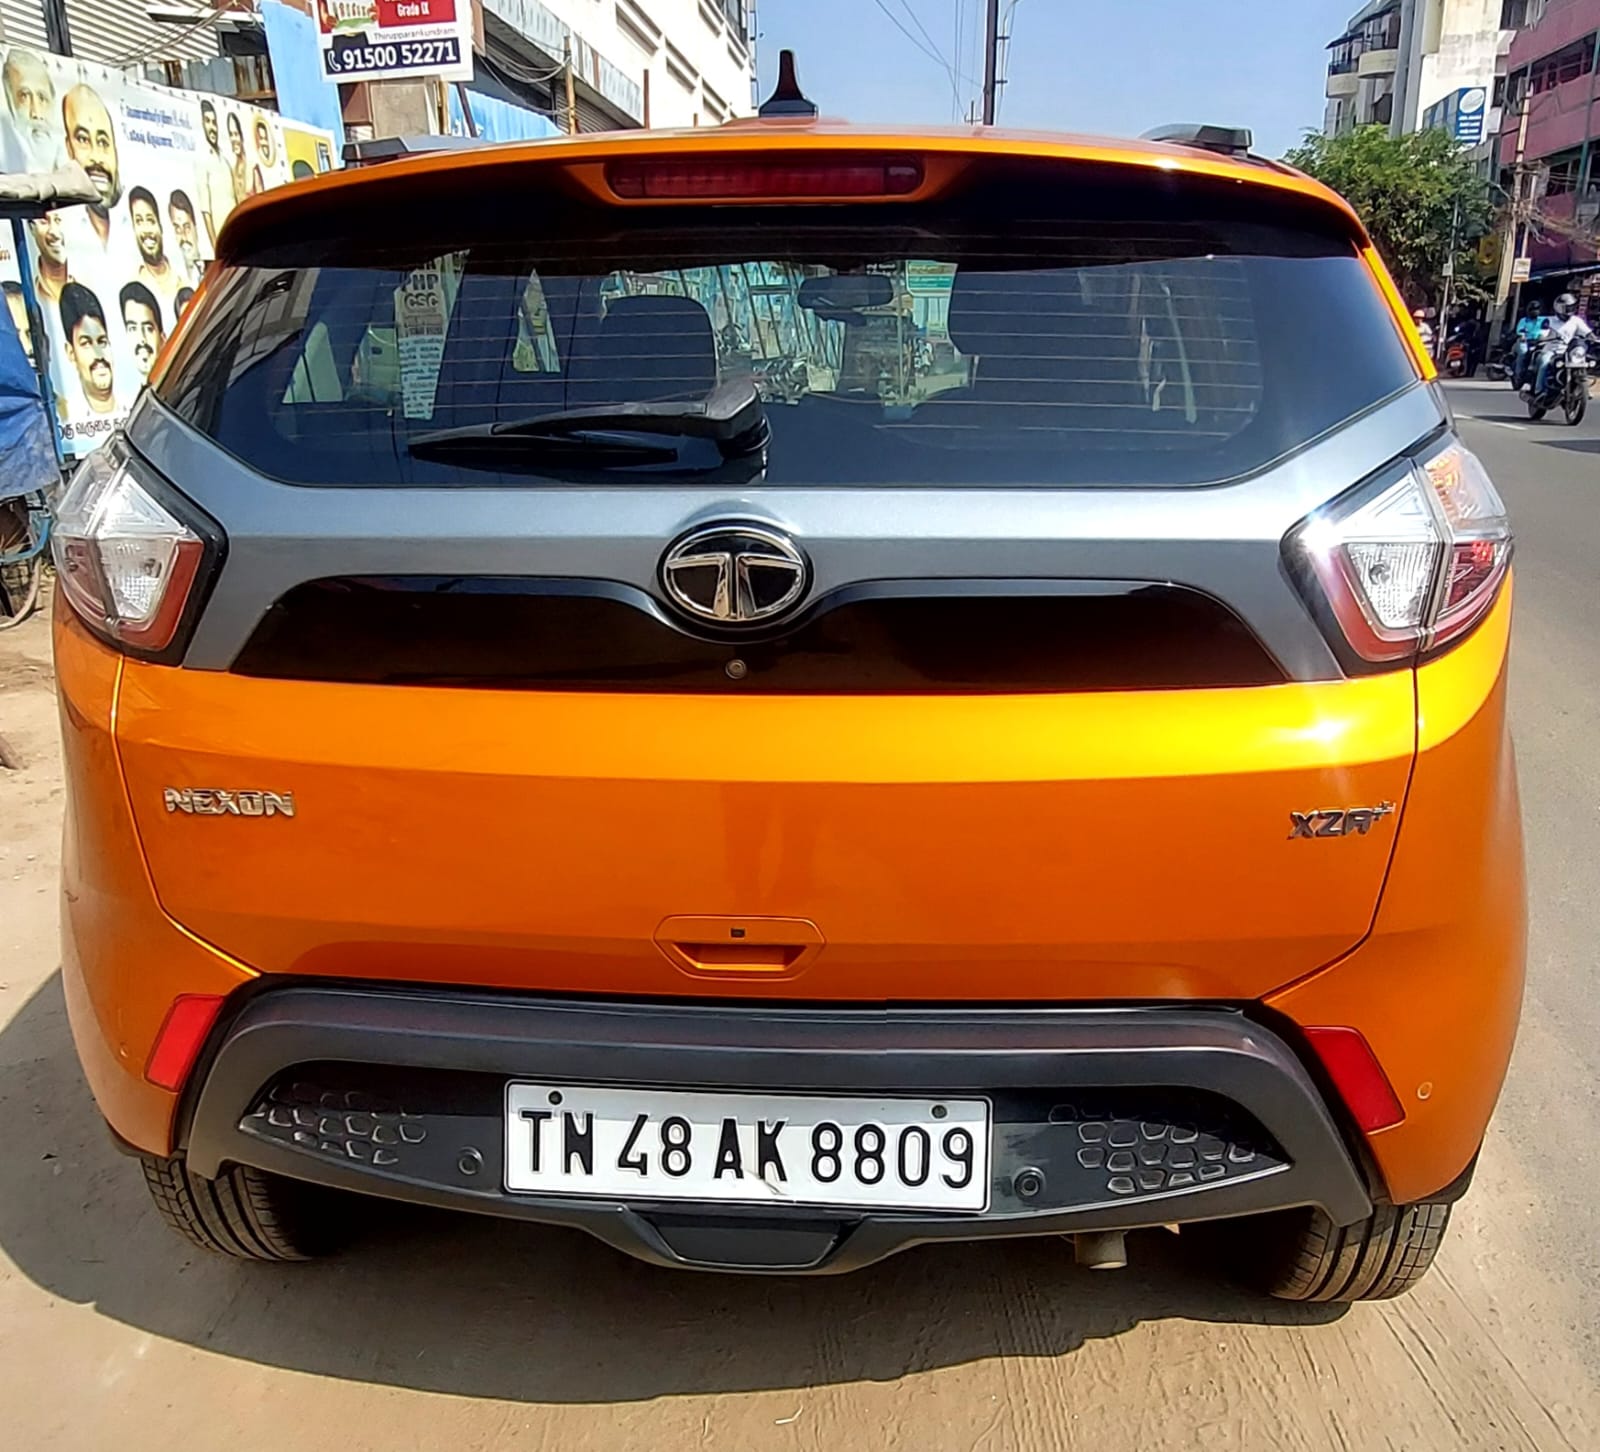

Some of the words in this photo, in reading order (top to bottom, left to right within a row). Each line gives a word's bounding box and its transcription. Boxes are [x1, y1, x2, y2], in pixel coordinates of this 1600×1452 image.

[397, 3, 420, 17] Grade
[342, 46, 397, 70] 91500
[402, 40, 457, 64] 52271
[404, 292, 439, 310] CSC
[163, 787, 294, 817] NEXON
[520, 1110, 595, 1176] TN
[617, 1113, 692, 1178] 48
[713, 1117, 788, 1183] AK
[810, 1121, 975, 1189] 8809
